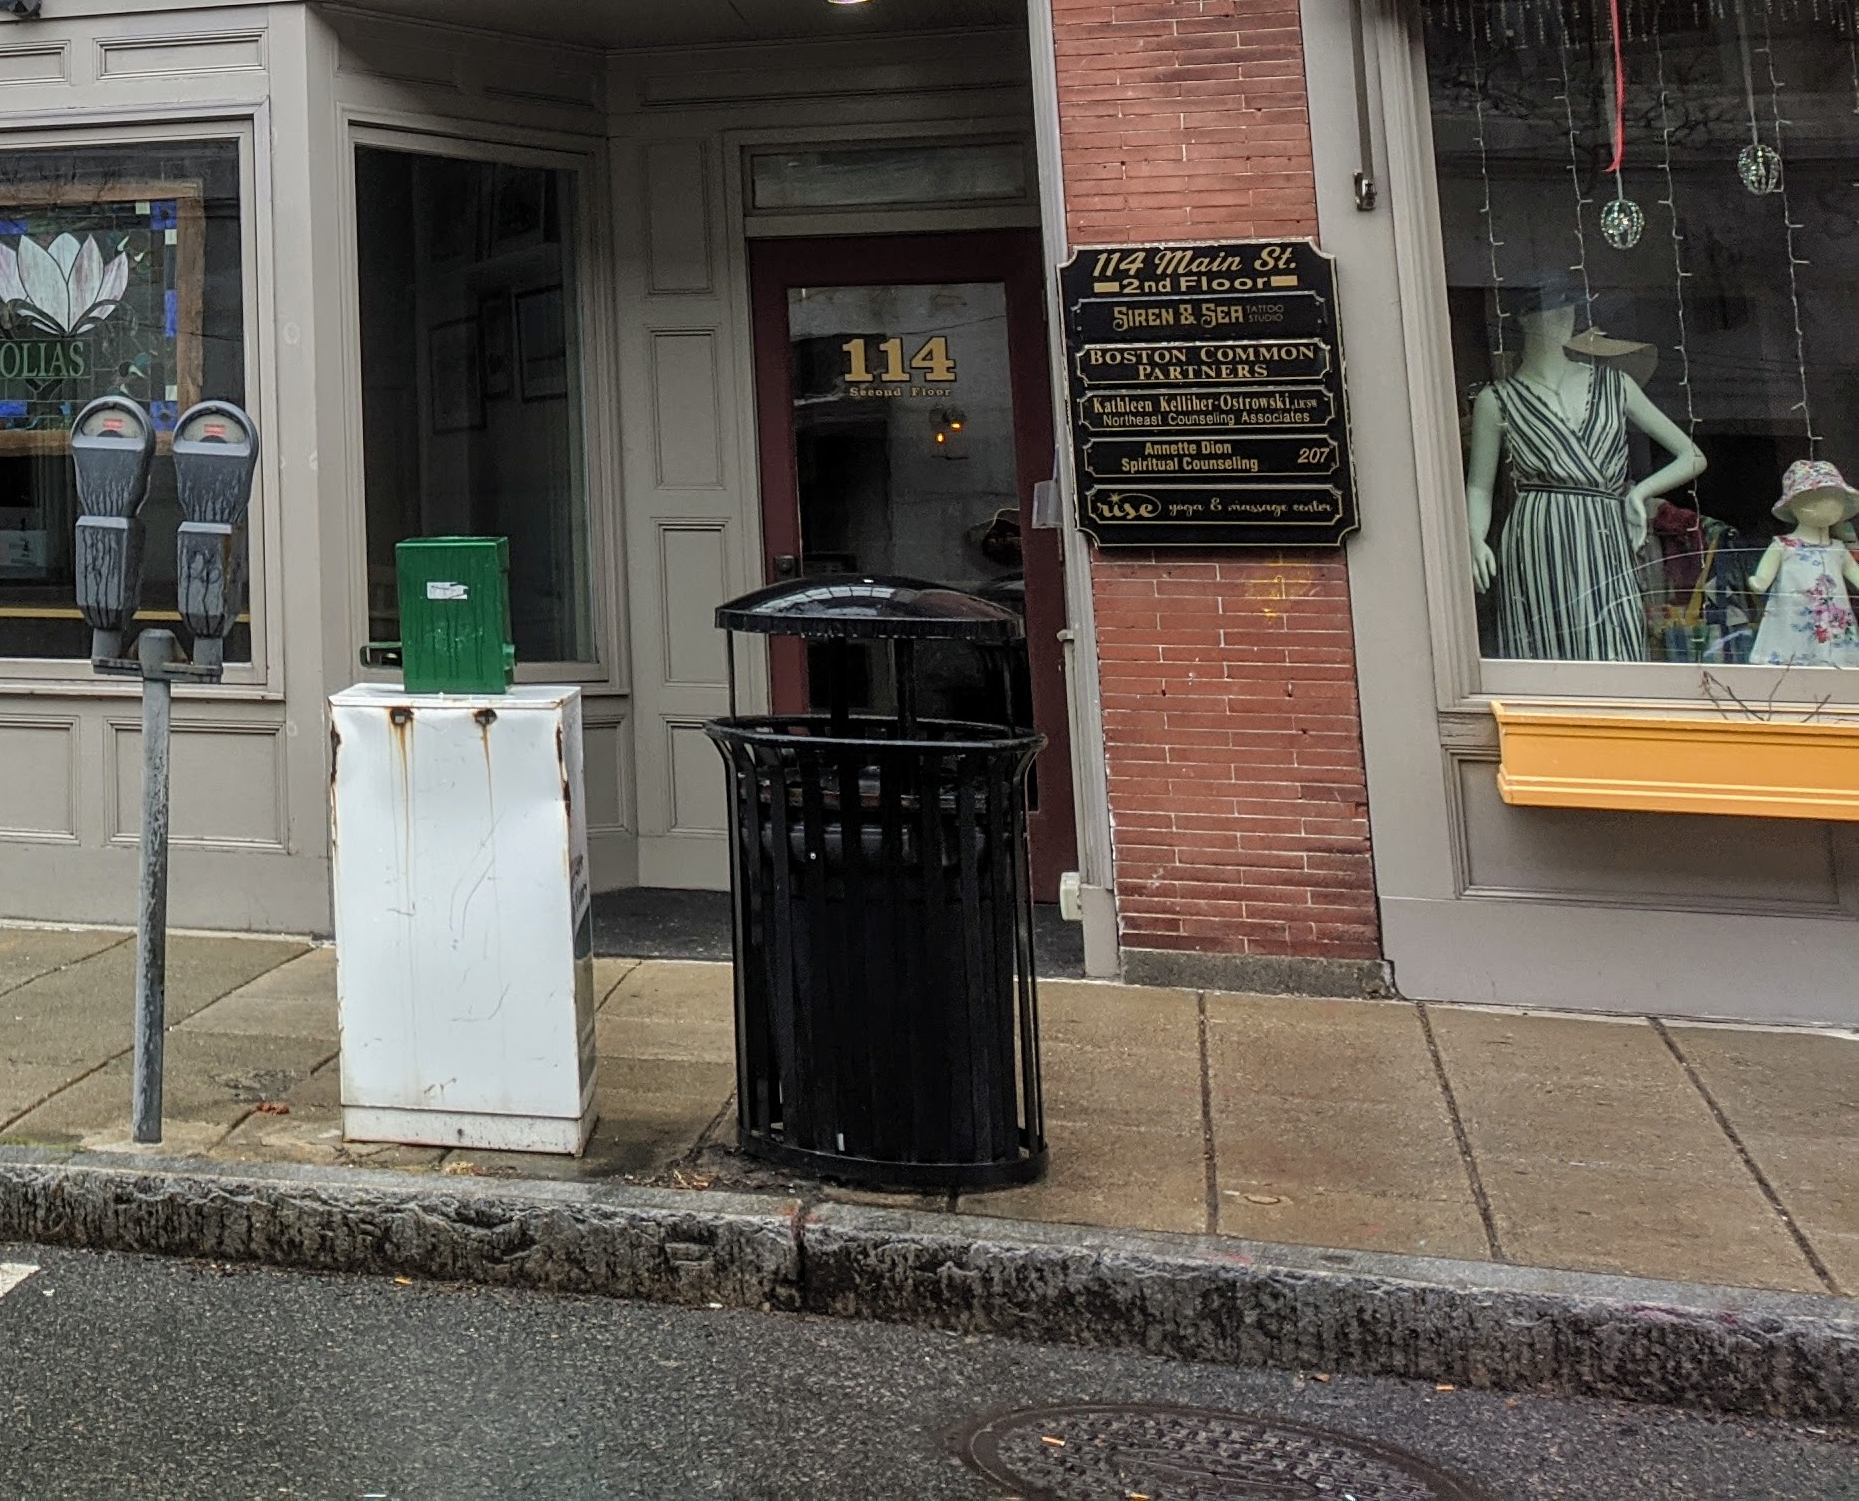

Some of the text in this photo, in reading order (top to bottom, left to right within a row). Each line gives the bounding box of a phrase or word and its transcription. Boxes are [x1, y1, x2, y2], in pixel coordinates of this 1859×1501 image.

[1093, 246, 1298, 277] 114 Main St.
[1121, 275, 1268, 294] 2nd Floor
[1113, 303, 1244, 331] SIREN & SEA
[1246, 304, 1284, 314] TATTOO
[1248, 313, 1284, 323] STUDIO
[842, 336, 957, 383] 114
[1090, 344, 1315, 365] BOSTON COMMON
[1138, 364, 1269, 380] PARTNERS
[849, 387, 951, 397] Second Floor
[1093, 396, 1153, 414] Kathleen
[1103, 410, 1310, 426] Northeast Counseling Associates
[1145, 441, 1232, 456] Annette Dion
[1297, 447, 1330, 464] 207
[1121, 457, 1259, 473] Spiritual Counseling
[1097, 497, 1334, 520] rise yoga & massage center
